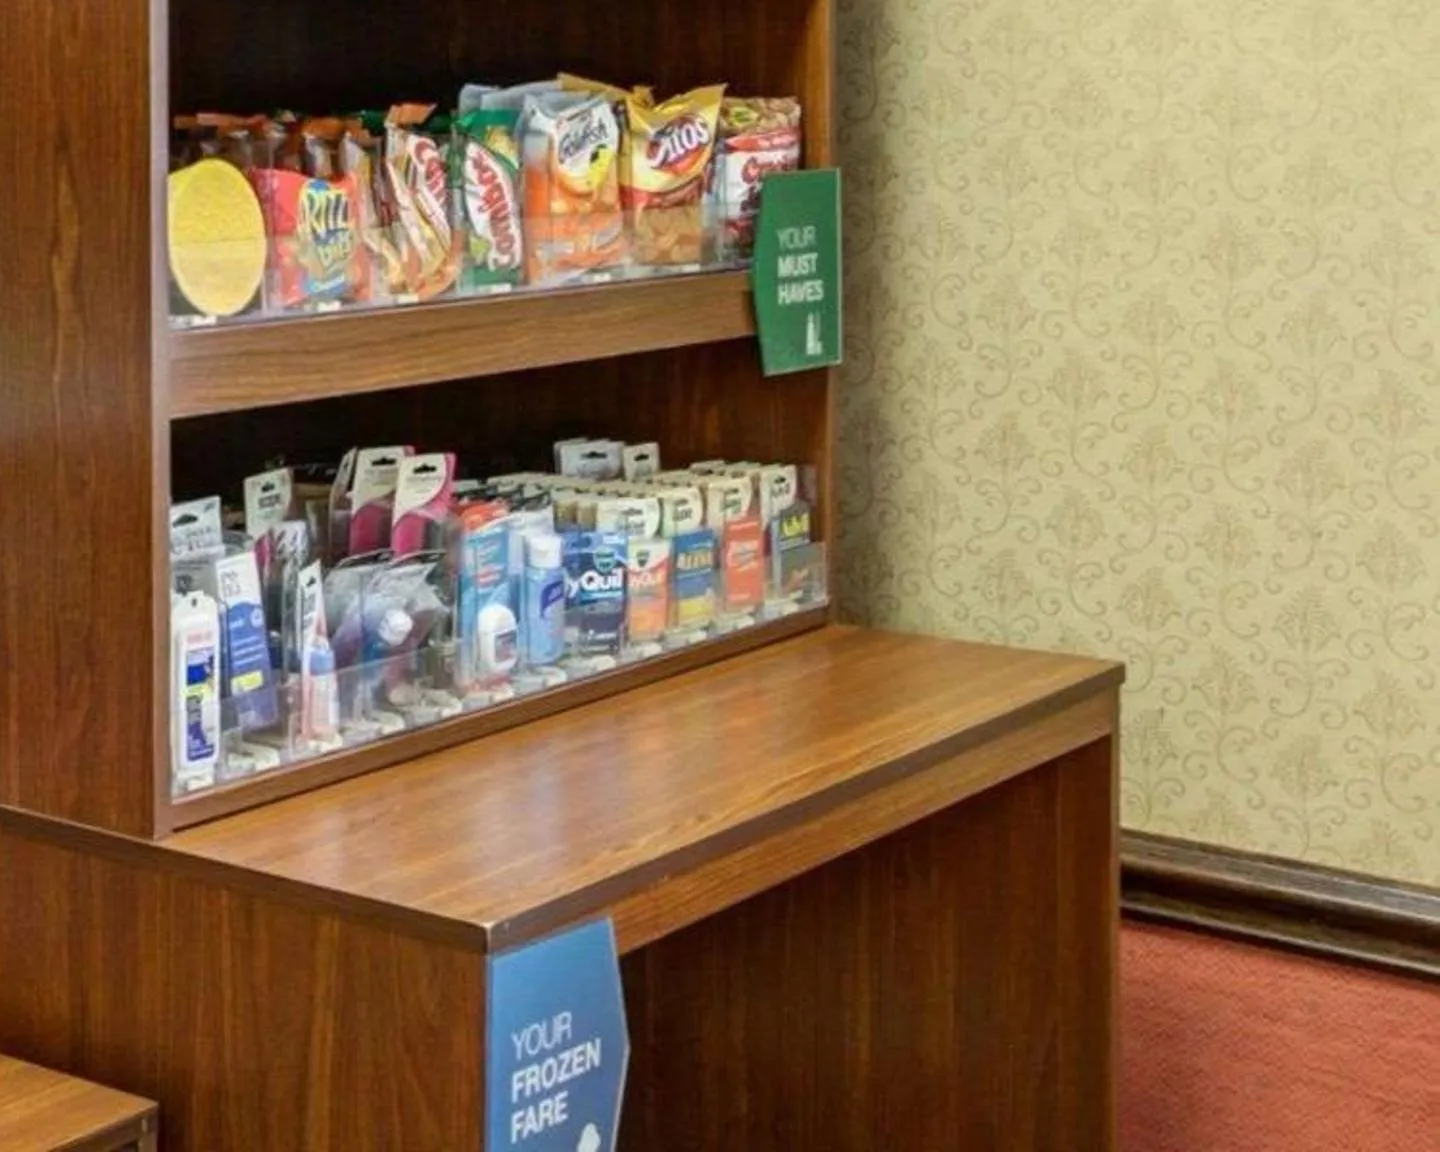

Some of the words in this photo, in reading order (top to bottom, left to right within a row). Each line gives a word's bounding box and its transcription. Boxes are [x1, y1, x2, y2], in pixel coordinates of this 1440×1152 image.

[777, 224, 817, 249] YOUR
[777, 252, 818, 277] MUST
[777, 279, 825, 305] HAVES
[511, 1010, 572, 1061] YOUR
[511, 1037, 602, 1105] FROZEN
[511, 1090, 569, 1145] FARE
